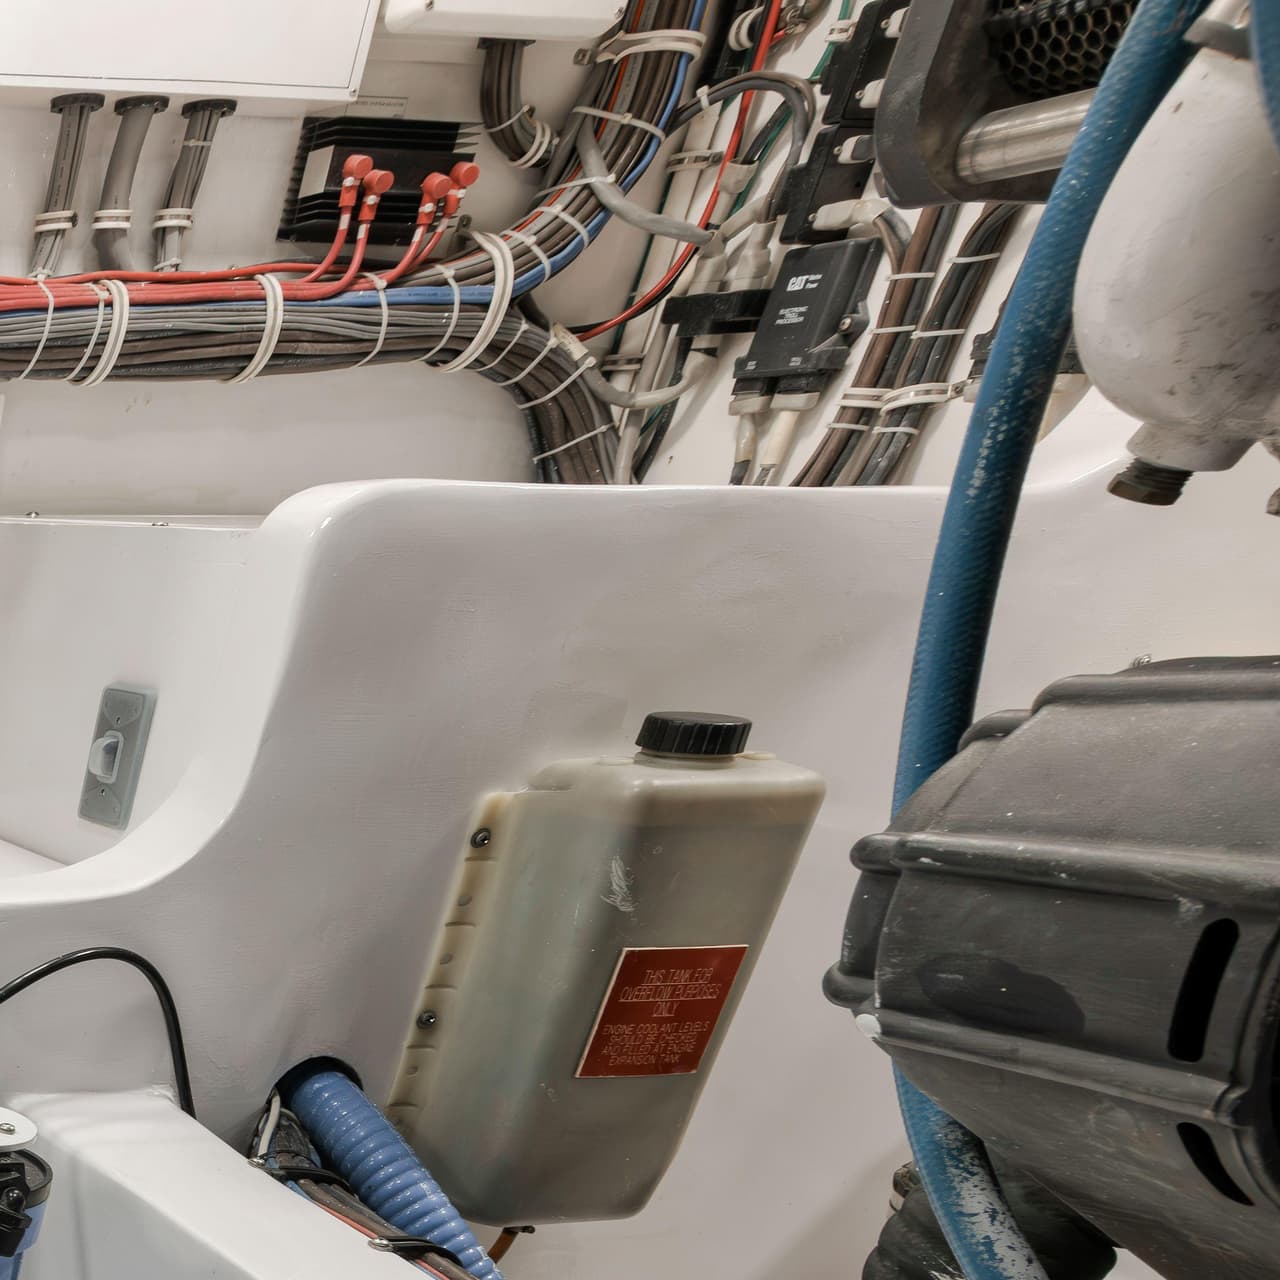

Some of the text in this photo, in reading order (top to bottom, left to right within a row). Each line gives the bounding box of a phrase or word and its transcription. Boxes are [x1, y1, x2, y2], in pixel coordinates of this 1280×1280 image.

[787, 275, 809, 291] CAT
[645, 968, 714, 983] THIS TANK FOR
[620, 984, 722, 1000] OVERFLOW PURPOSES
[654, 1002, 680, 1016] ONLY
[602, 1021, 710, 1035] ENGINE COOLANT LEVELS
[610, 1033, 697, 1045] SHOULD BE CHECKED
[601, 1043, 695, 1055] AND FILLED AT ENGINE
[609, 1054, 681, 1066] EXPANSION TANK
